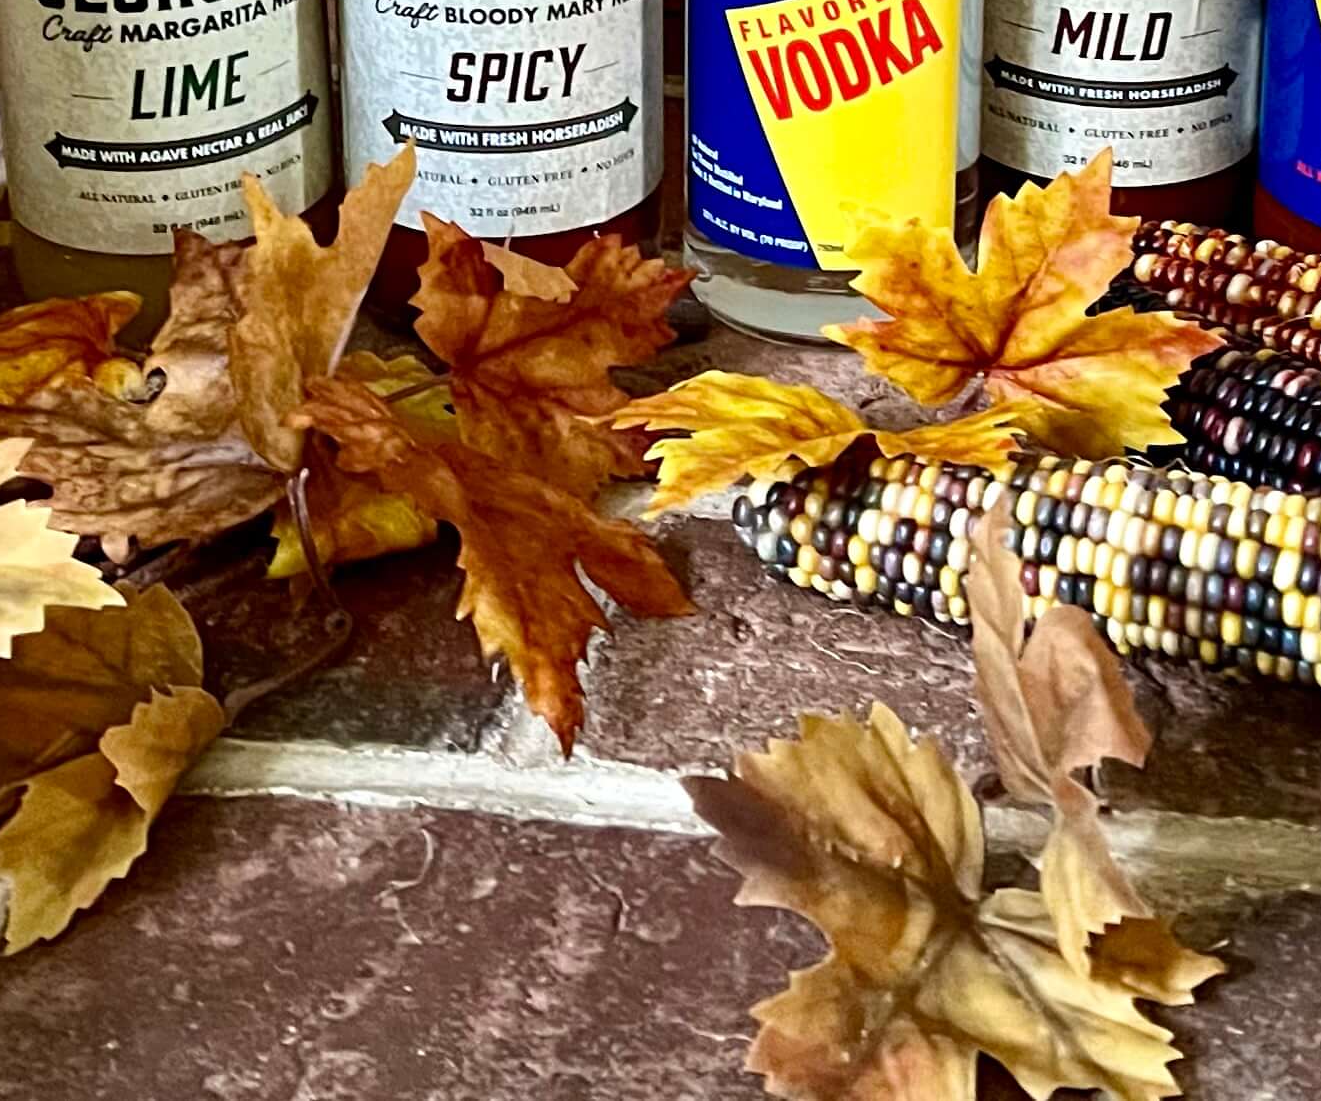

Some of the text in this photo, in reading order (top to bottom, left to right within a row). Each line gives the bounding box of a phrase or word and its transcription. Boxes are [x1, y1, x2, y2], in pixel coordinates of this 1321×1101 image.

[42, 14, 113, 52] Craft
[120, 0, 268, 45] MARGARITA
[445, 6, 538, 26] BLOODY
[1052, 7, 1173, 61] MILD
[130, 51, 250, 120] LIME
[447, 43, 588, 103] SPICY
[1001, 70, 1222, 100] MADE WITH FRESH HORSERADISH
[399, 111, 624, 147] MADE WITH FRESH HORSERADISH
[1085, 129, 1169, 139] GLUTEN FREE
[61, 144, 96, 162] MADE
[99, 150, 136, 163] WITH
[140, 148, 188, 163] AGAVE
[191, 136, 242, 157] NECTAR
[487, 172, 540, 187] GLUTEN
